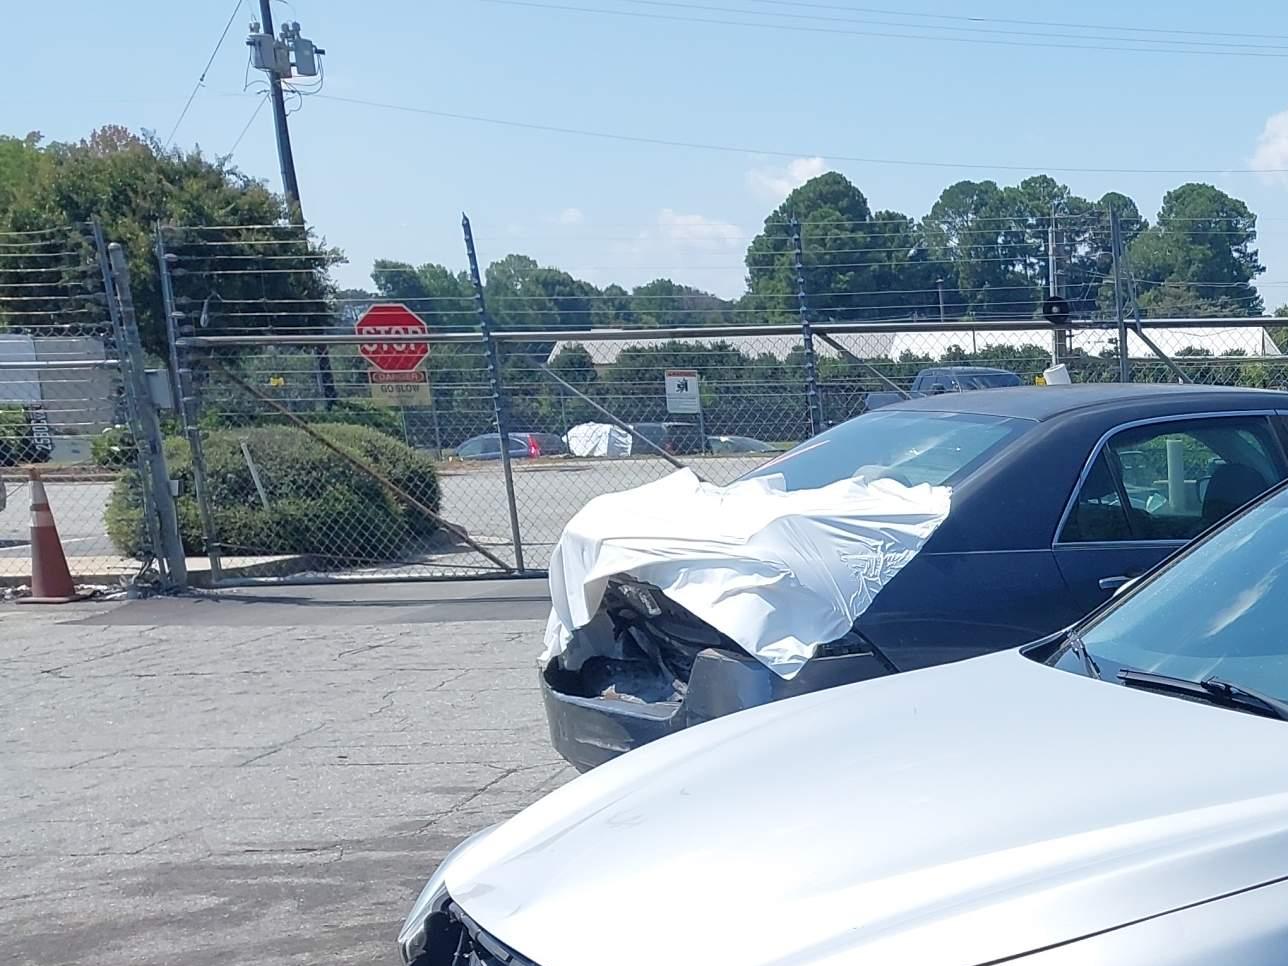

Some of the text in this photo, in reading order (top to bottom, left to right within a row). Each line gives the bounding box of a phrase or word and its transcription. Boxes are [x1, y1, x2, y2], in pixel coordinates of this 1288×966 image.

[361, 327, 422, 351] STOP
[380, 384, 419, 393] GO SLOW
